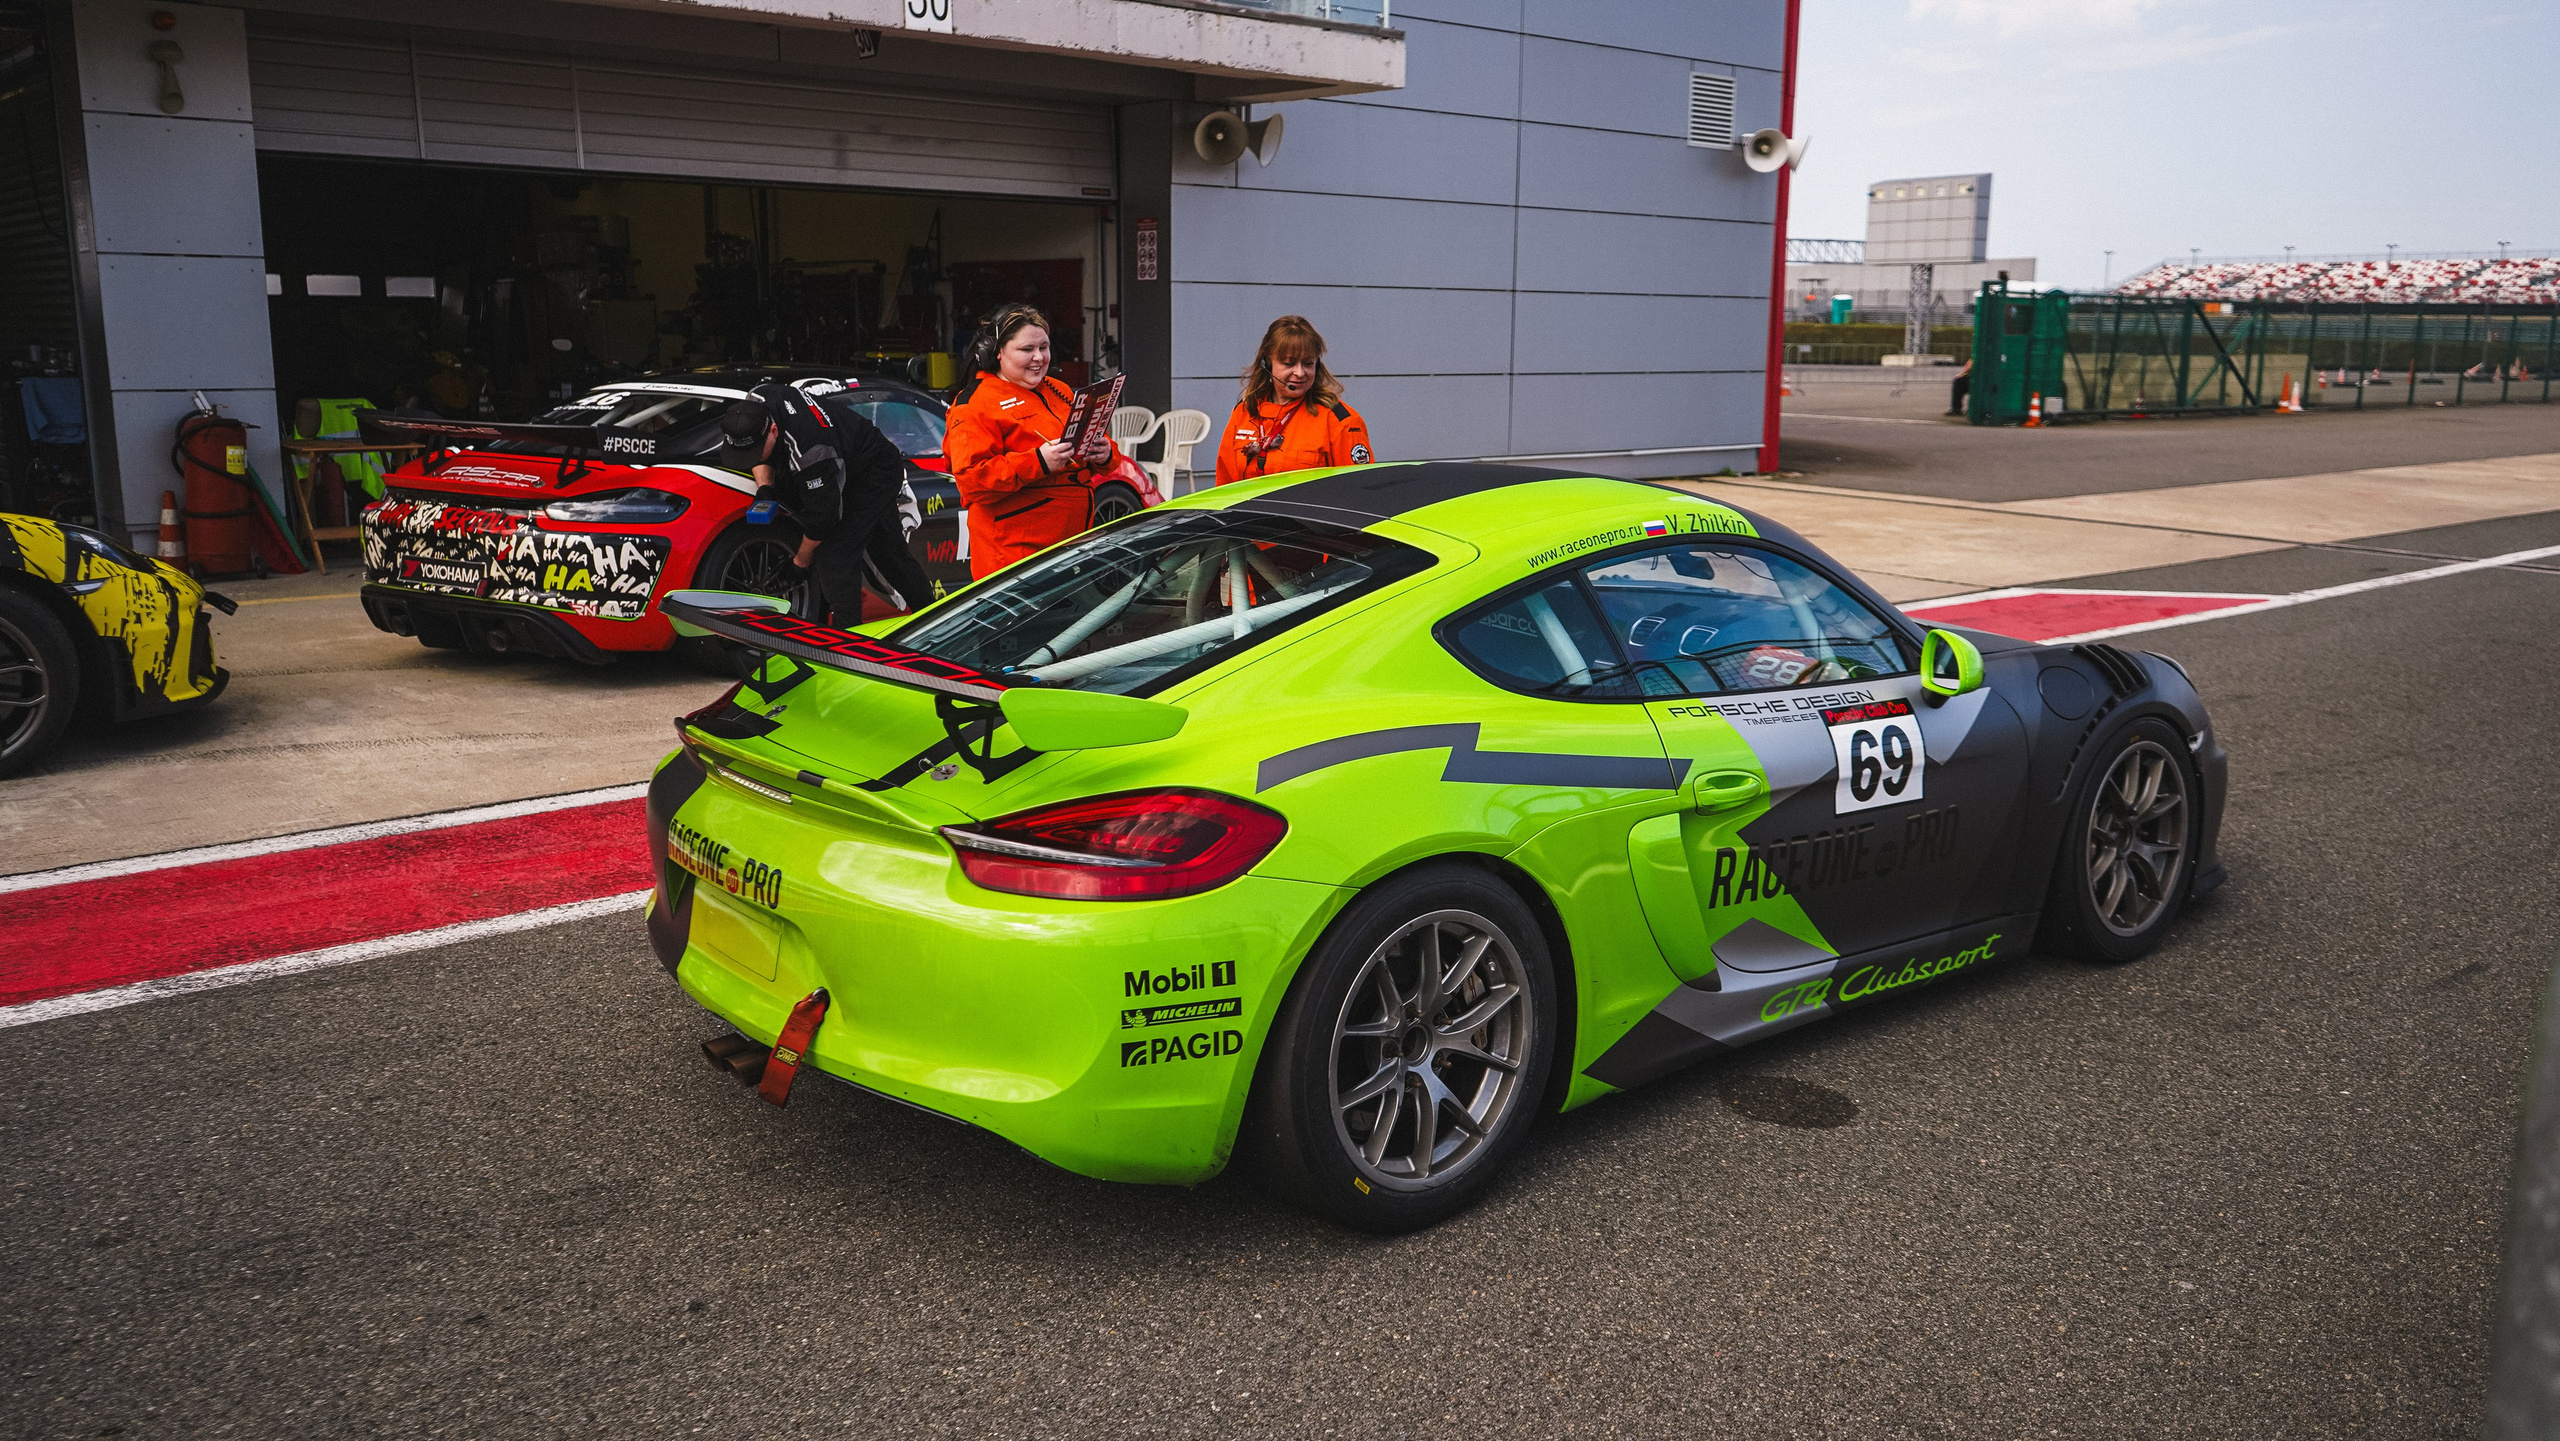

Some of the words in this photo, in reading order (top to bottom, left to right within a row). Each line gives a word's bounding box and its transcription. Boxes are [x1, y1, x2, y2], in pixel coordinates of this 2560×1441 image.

[1107, 379, 1123, 408] ROCKET
[1077, 404, 1105, 456] MOTUL
[603, 436, 656, 455] #PSCCE
[927, 493, 944, 516] HA
[1665, 515, 1685, 534] V.
[1686, 514, 1749, 534] Zhilkin
[544, 548, 563, 562] HA
[567, 550, 588, 567] HA
[593, 540, 651, 578] HA
[927, 540, 958, 563] WHY
[1527, 525, 1642, 569] www.raceonepro.ru
[420, 563, 480, 584] YOKOHAMA
[516, 566, 536, 587] HA
[543, 564, 594, 593] HA
[591, 574, 607, 589] HA
[611, 574, 651, 599] HA
[1748, 655, 1807, 685] 28
[1668, 700, 1789, 719] PORSCHE
[1792, 690, 1876, 710] DESIGN
[1825, 708, 1866, 723] Porsche
[1864, 704, 1889, 718] Club
[1887, 702, 1908, 715] Cup
[1743, 712, 1819, 727] TIMEPIECES
[1850, 724, 1914, 803] 69
[668, 818, 731, 887] RACEONE
[741, 857, 782, 910] PRO
[1708, 822, 1875, 910] RACEONE
[1124, 964, 1205, 998] Mobil
[1760, 977, 1835, 1023] GT4
[1838, 933, 2002, 1003] Clubsport
[1151, 1001, 1237, 1021] MICHELIN
[776, 1049, 798, 1062] OMP
[1151, 1029, 1244, 1065] PAGID
